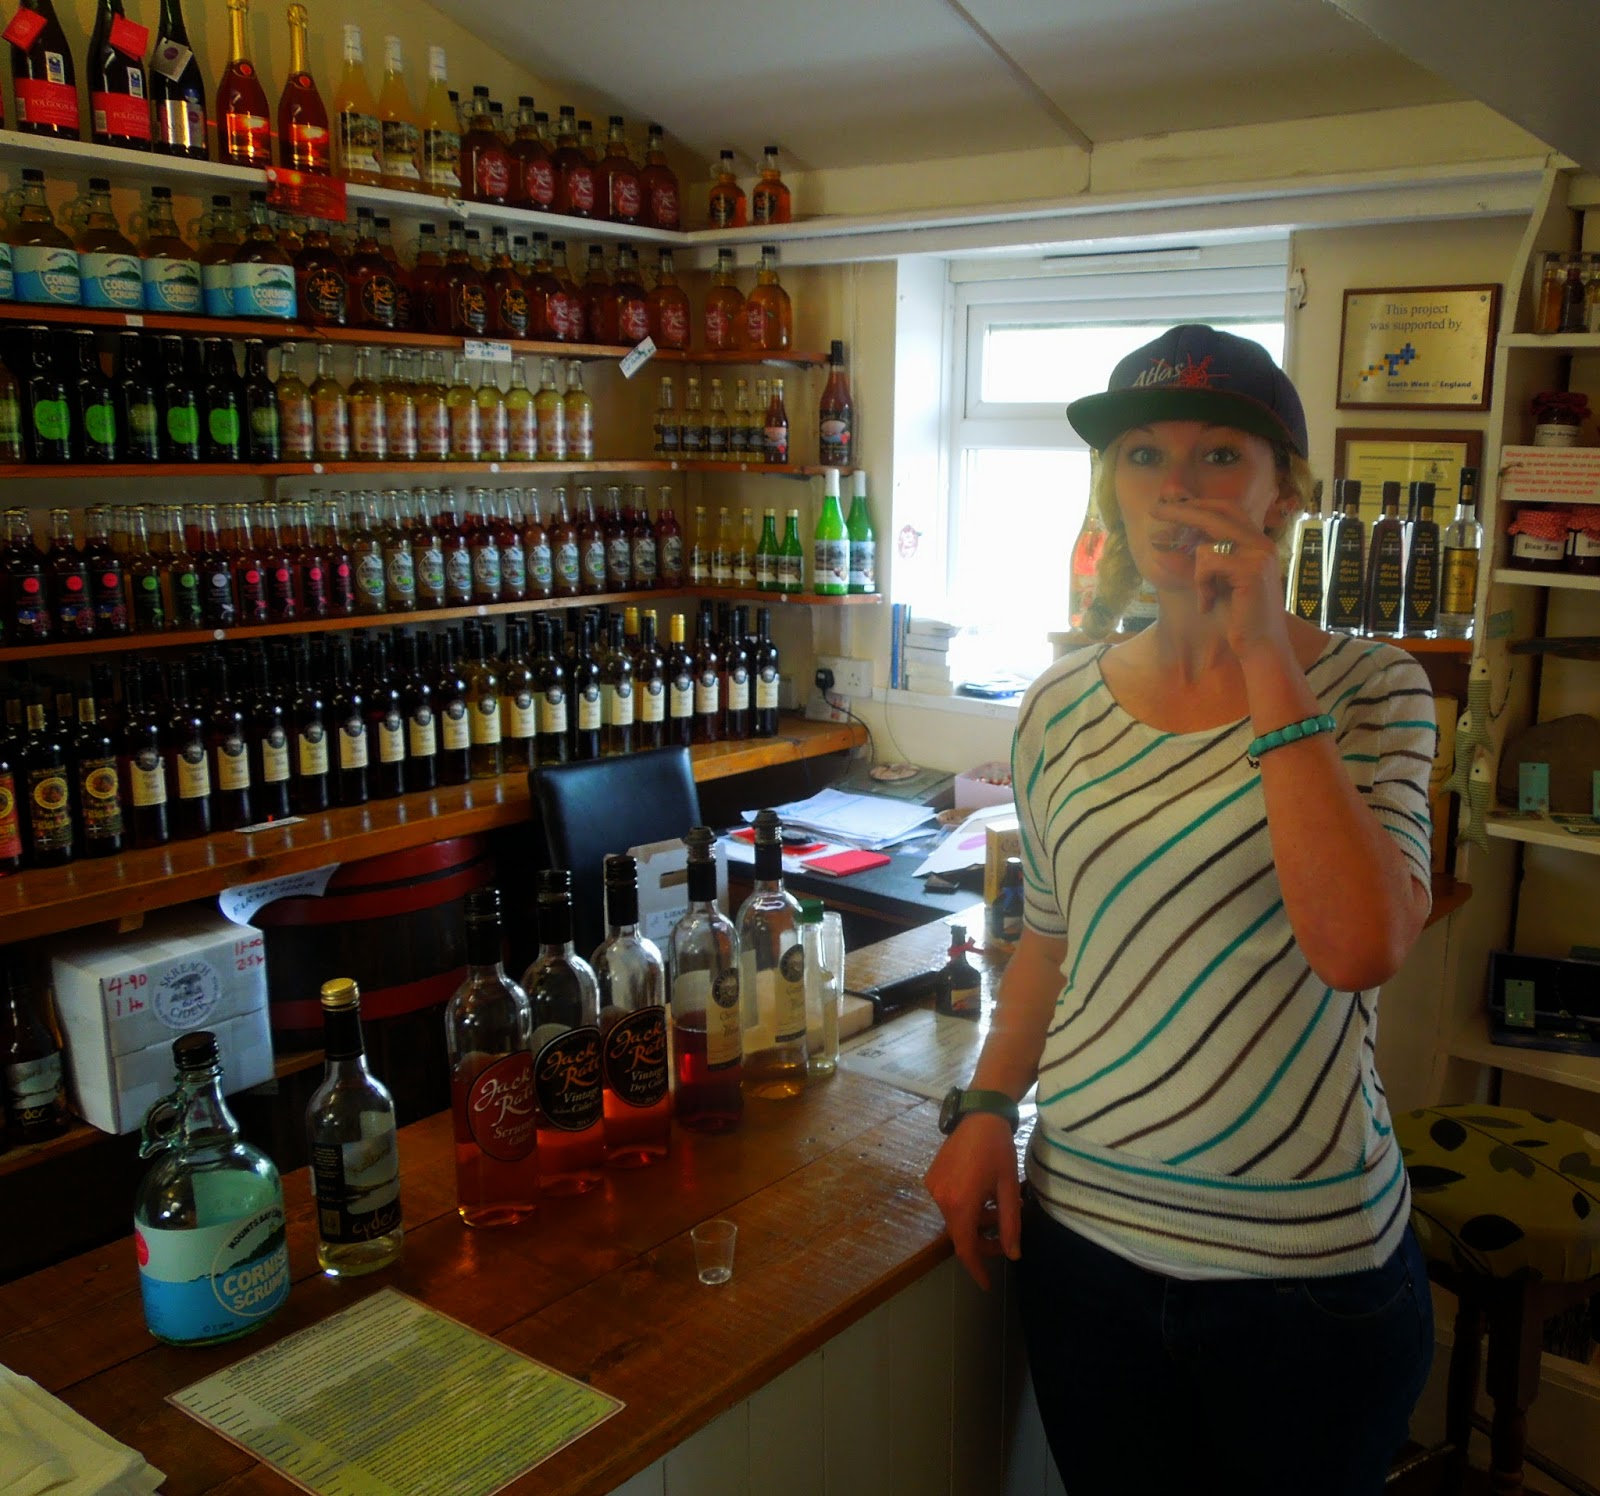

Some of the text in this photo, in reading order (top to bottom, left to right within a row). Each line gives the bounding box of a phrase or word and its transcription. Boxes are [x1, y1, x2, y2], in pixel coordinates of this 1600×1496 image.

[1370, 318, 1463, 333] was supported by
[1385, 303, 1449, 318] This project
[1131, 358, 1184, 387] Atlas
[1387, 380, 1409, 388] South
[1410, 380, 1430, 388] West
[1440, 380, 1473, 390] England
[169, 999, 213, 1020] CIDER
[609, 1020, 663, 1060] Jack
[541, 1041, 597, 1081] Jack
[473, 1066, 531, 1113] Jack
[494, 1116, 537, 1140] Scrum
[228, 1217, 260, 1250] MOUNTS
[223, 1246, 287, 1297] CORNIS
[232, 1264, 288, 1311] SCRUM
